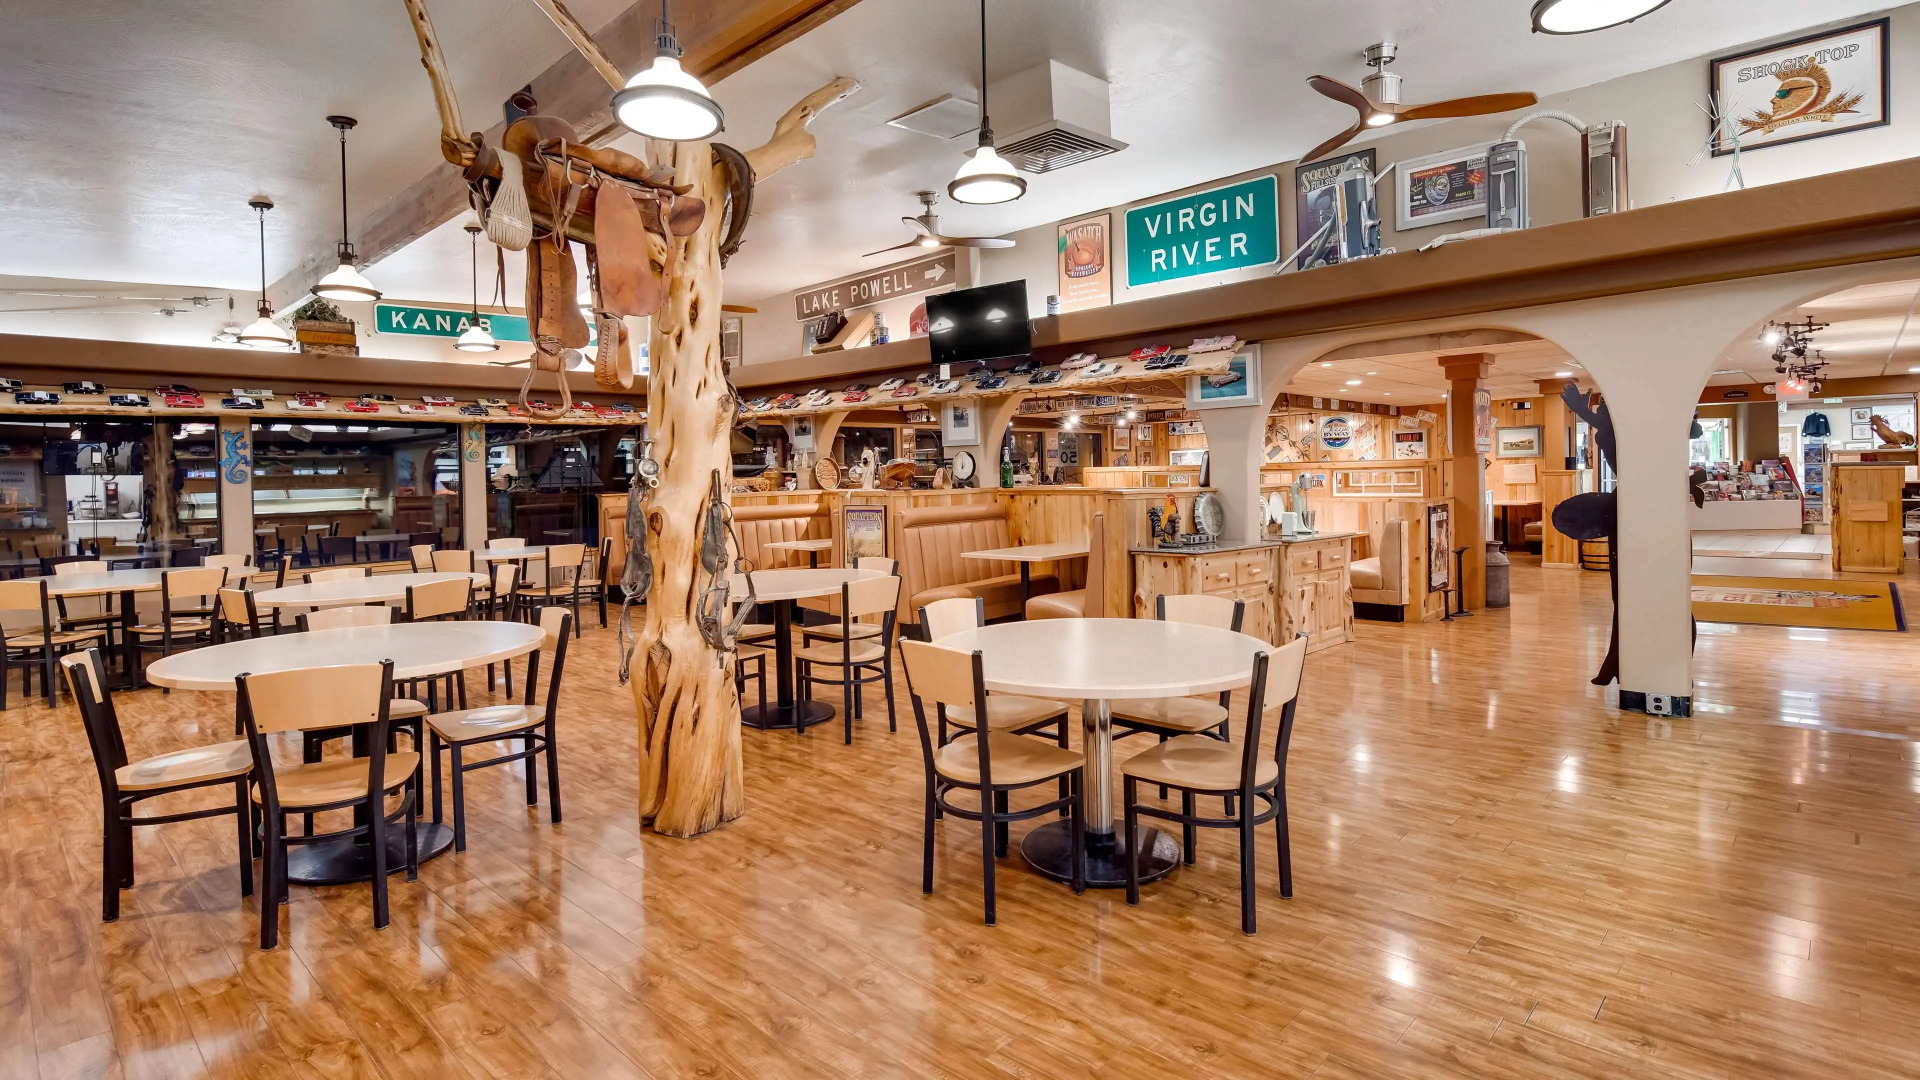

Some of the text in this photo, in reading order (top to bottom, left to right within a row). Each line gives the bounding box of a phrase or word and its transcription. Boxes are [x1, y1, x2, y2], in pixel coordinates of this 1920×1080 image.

[1738, 43, 1860, 83] SHOCK TOP
[1301, 156, 1370, 194] SQUATTS
[1066, 225, 1102, 244] WASATCH
[1144, 192, 1254, 238] VIRGIN
[1151, 232, 1248, 272] RIVER
[803, 271, 912, 314] LAKE POWELL
[391, 310, 491, 334] KANAB
